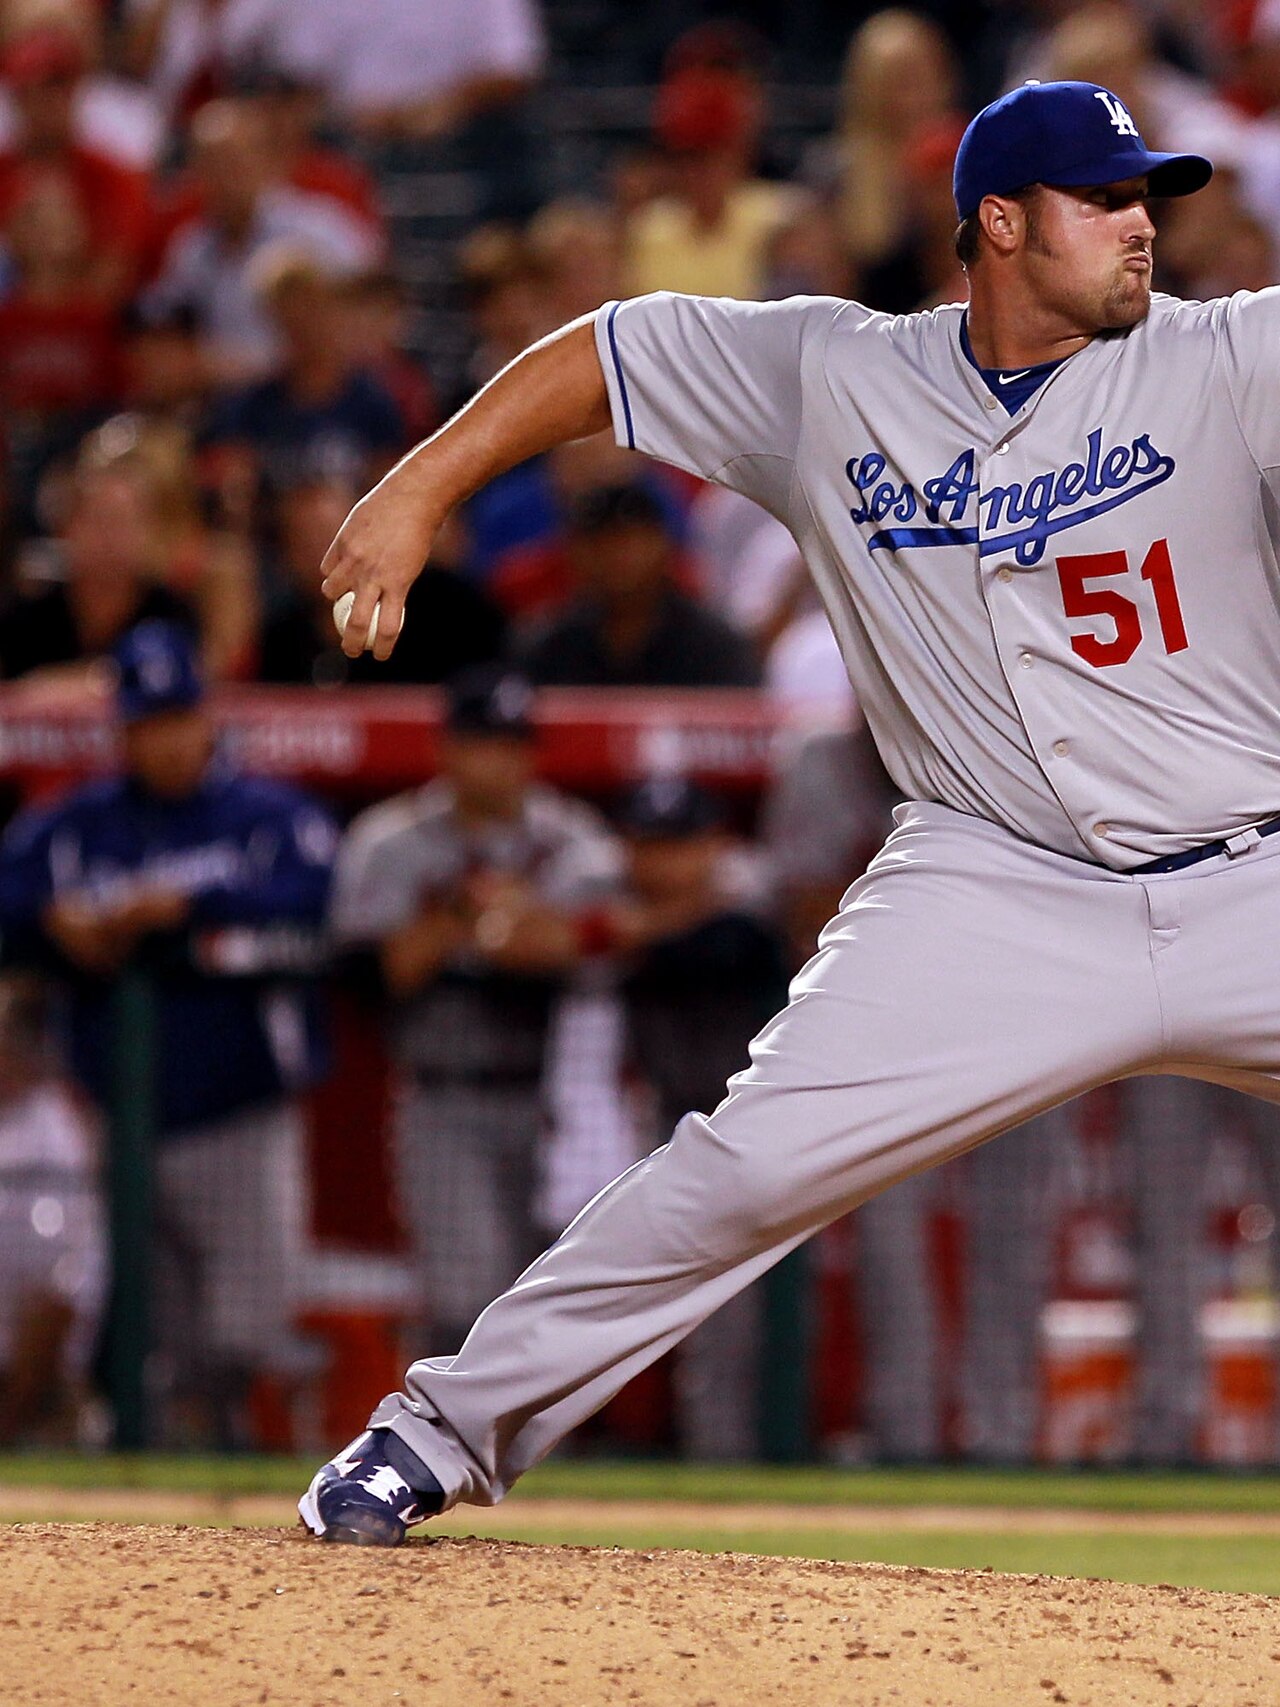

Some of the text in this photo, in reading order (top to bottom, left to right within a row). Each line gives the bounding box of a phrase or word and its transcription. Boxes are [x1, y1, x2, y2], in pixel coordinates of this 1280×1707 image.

[1094, 92, 1139, 137] LA
[845, 427, 1176, 566] Los Angeles
[1055, 537, 1190, 668] 51
